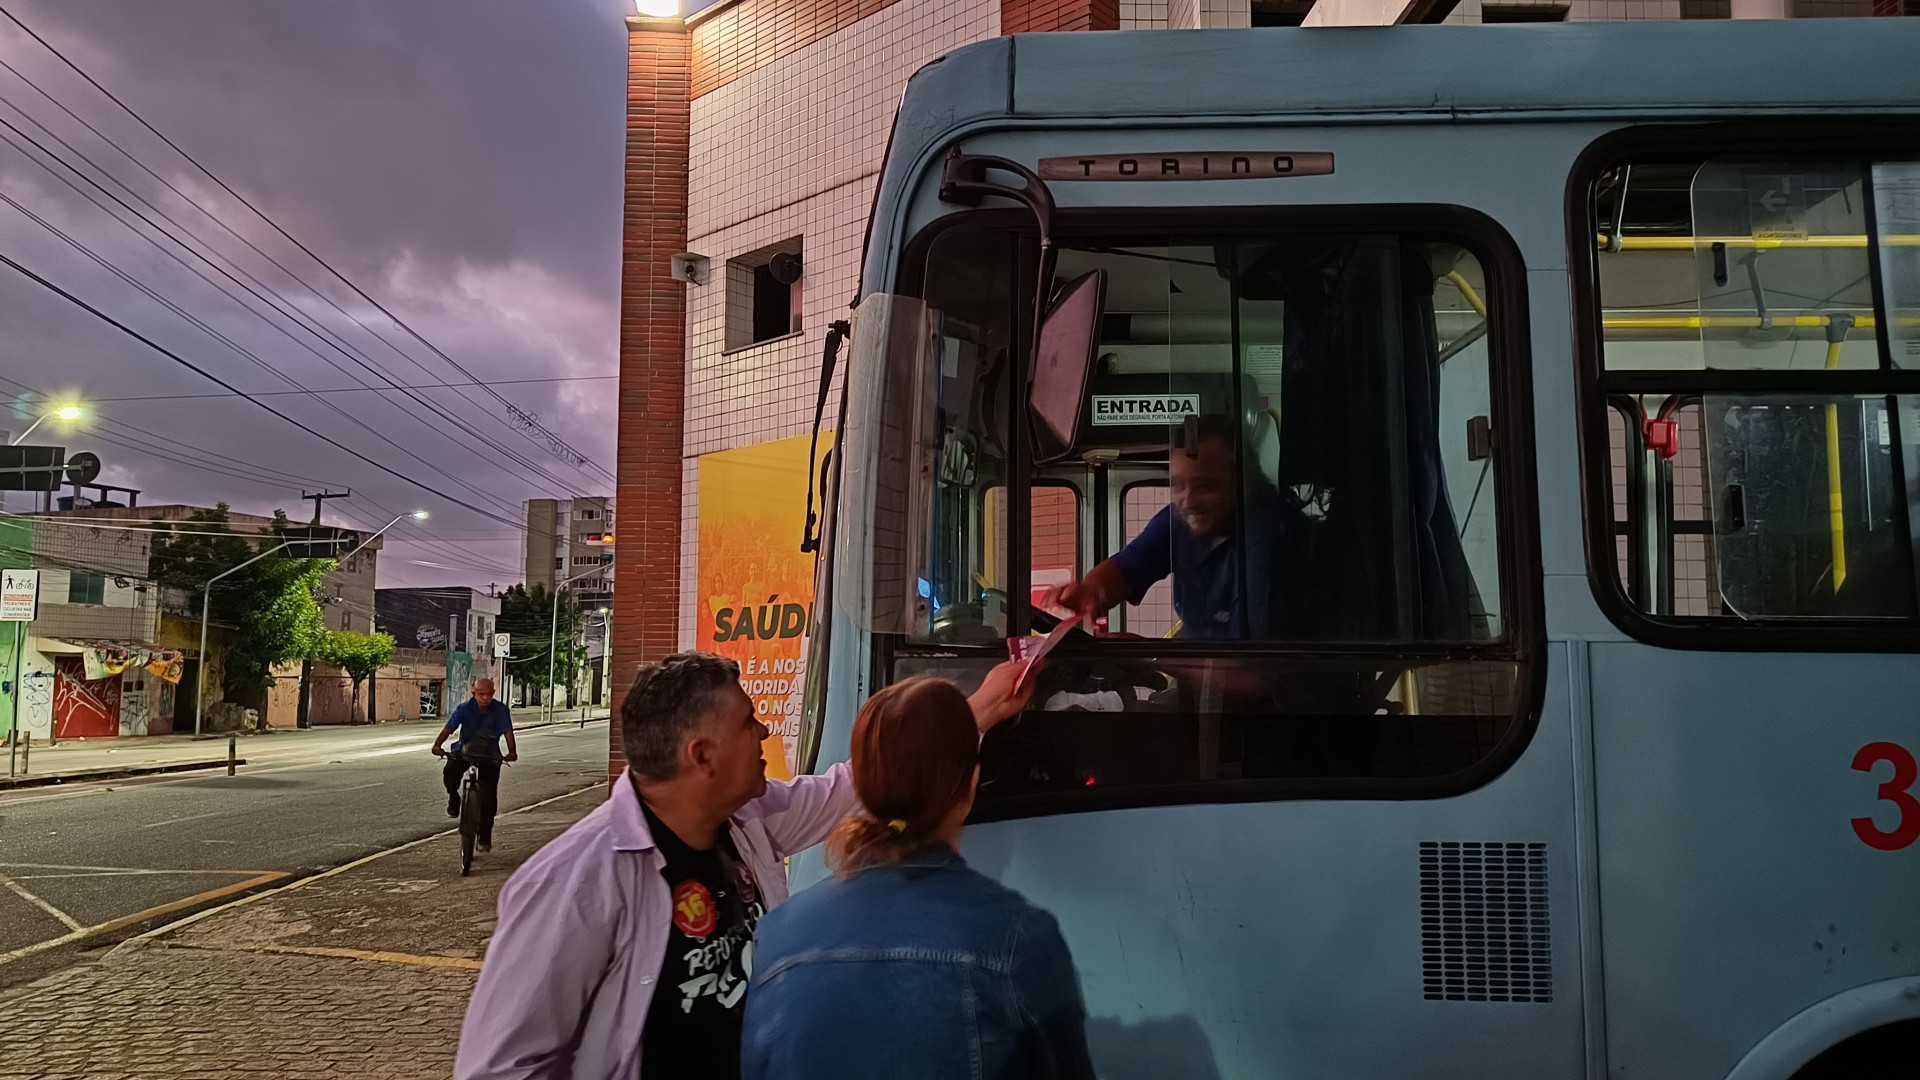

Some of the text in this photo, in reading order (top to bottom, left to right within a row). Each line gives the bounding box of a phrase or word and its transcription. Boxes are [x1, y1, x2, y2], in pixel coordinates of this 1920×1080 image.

[1078, 156, 1294, 177] TORINO
[1097, 400, 1194, 414] ENTRADA
[1097, 413, 1106, 421] NÃO
[747, 655, 756, 675] É
[758, 659, 769, 674] A
[758, 699, 769, 716] O
[1850, 741, 1920, 851] 3
[677, 893, 706, 923] 16
